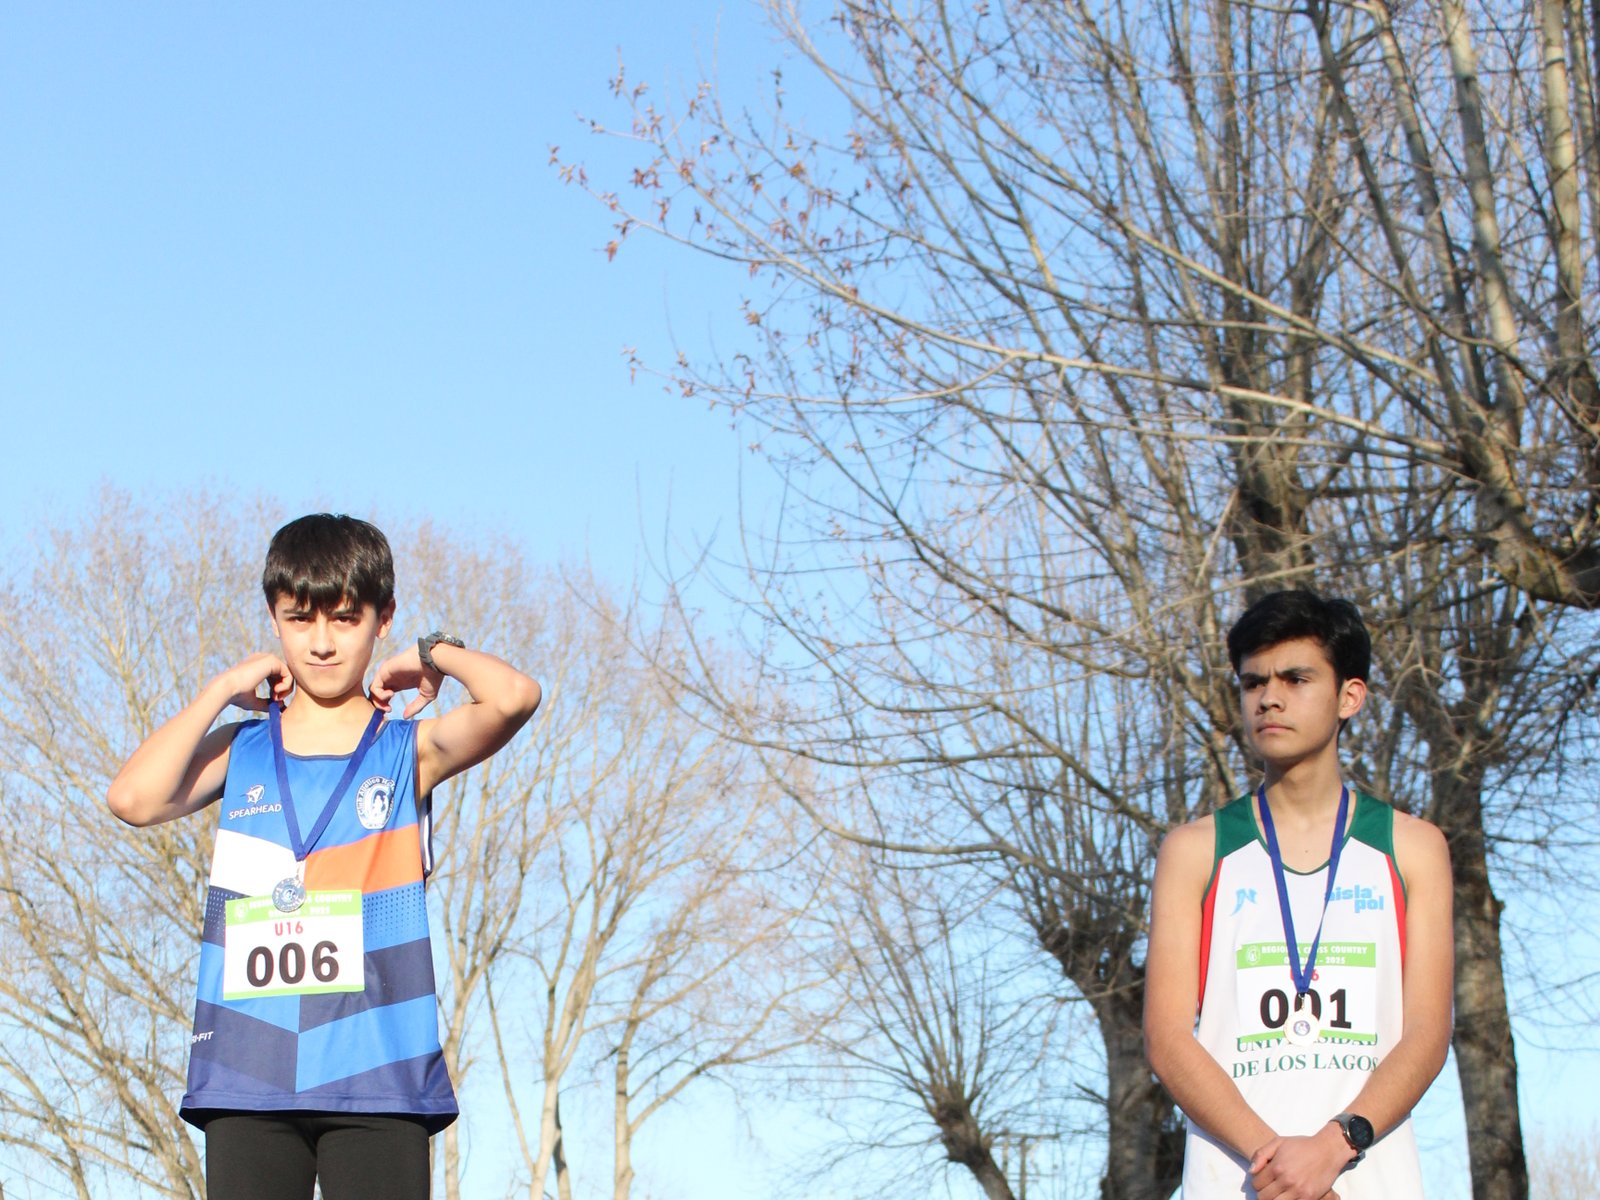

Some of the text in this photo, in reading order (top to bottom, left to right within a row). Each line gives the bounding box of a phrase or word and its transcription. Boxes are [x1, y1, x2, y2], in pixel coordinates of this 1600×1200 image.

[229, 803, 282, 820] SPEARHEAD
[1354, 895, 1384, 914] pol
[274, 921, 304, 936] U16
[247, 941, 339, 987] 006
[1260, 988, 1352, 1030] 001
[1232, 1060, 1260, 1078] DE
[1264, 1054, 1306, 1073] LOS
